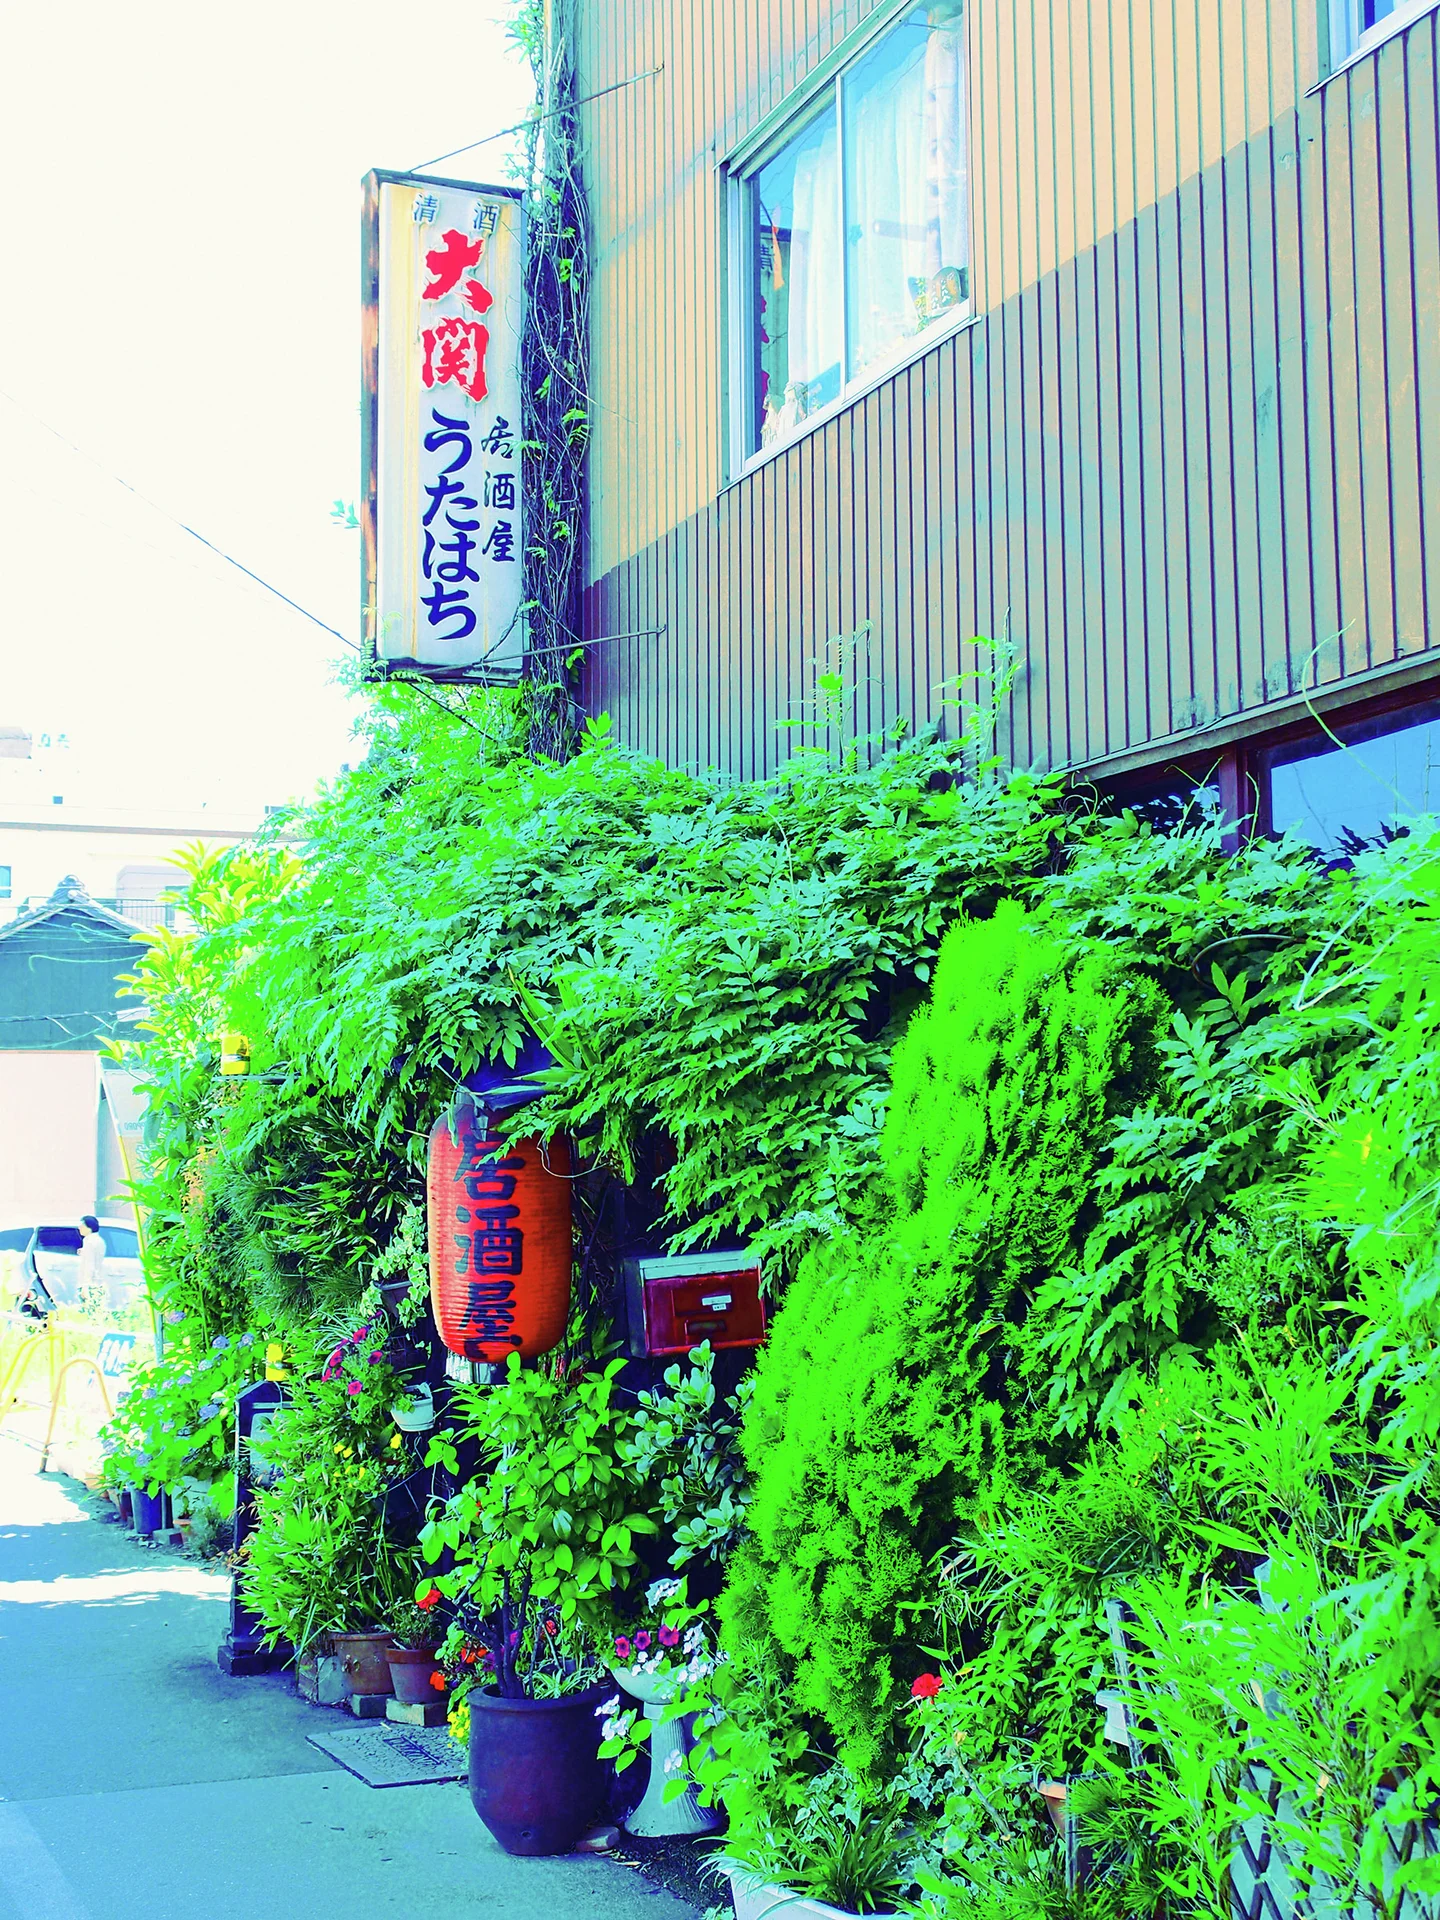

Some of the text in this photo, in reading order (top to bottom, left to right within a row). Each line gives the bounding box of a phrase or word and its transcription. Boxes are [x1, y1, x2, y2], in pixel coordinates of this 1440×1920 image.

[413, 194, 498, 231] 清酒
[422, 229, 493, 402] 大関
[420, 407, 480, 640] うたはち
[481, 416, 516, 562] 居酒屋
[453, 1133, 526, 1359] 居酒屋
